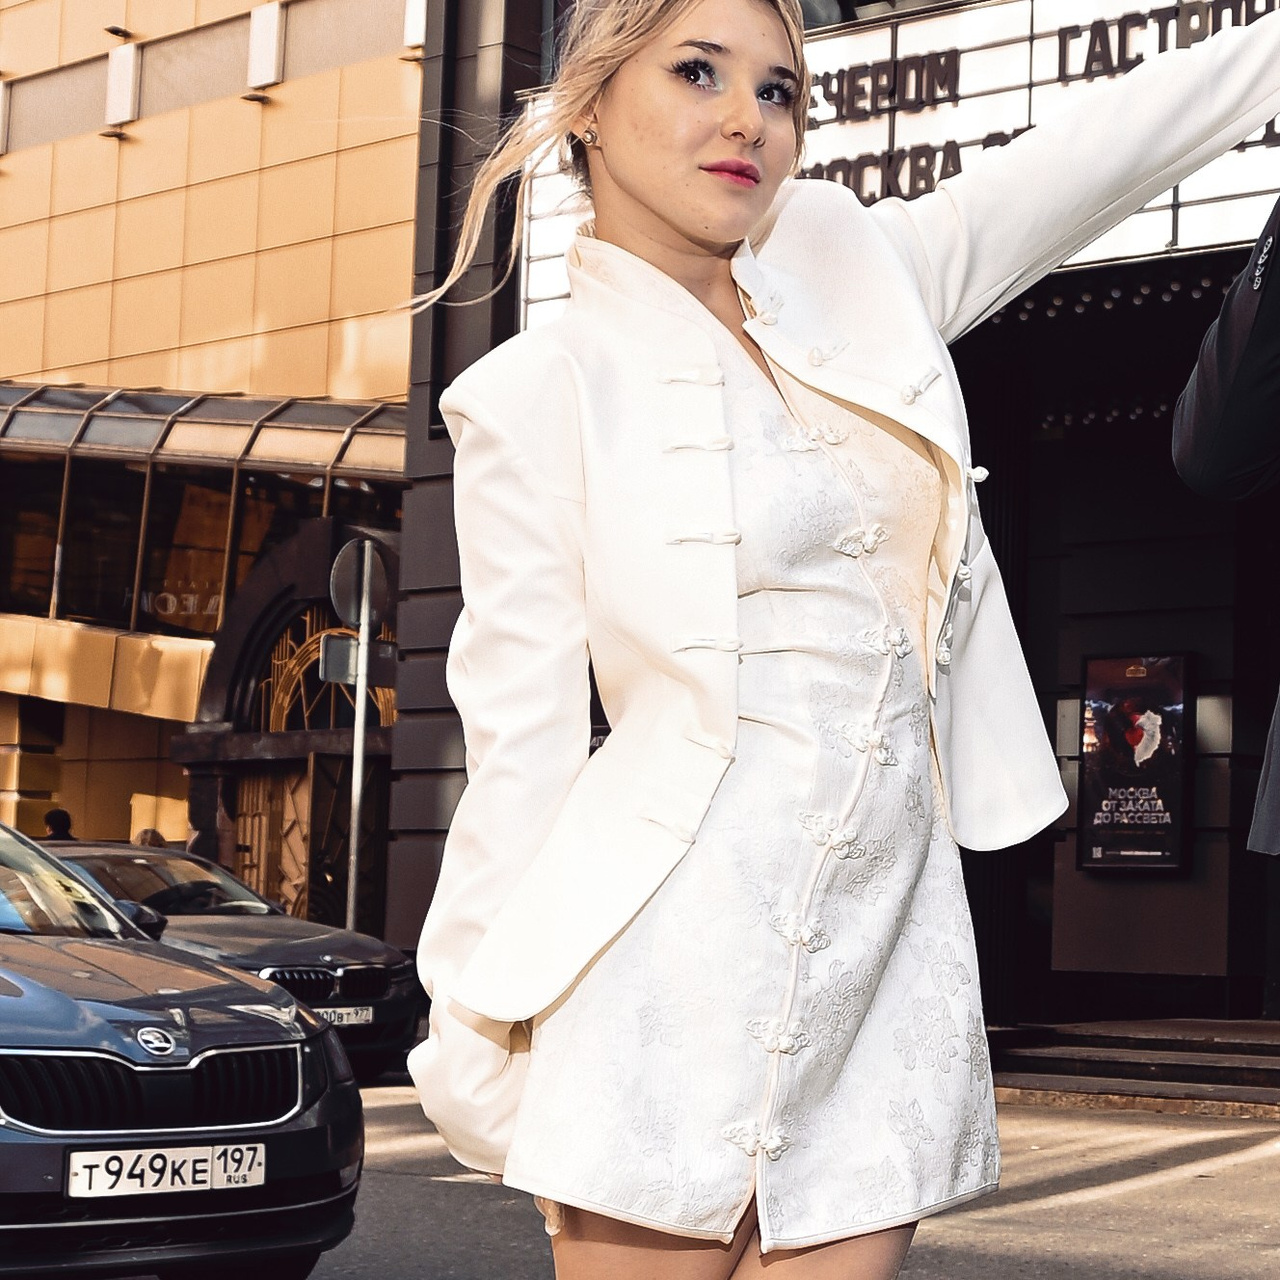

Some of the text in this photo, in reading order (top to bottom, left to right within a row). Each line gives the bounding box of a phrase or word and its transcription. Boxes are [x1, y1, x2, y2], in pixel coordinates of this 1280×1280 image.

[1108, 787, 1157, 799] МОСКВА
[1101, 799, 1164, 811] ОТ ЗАКАТА
[1093, 812, 1172, 825] ДО РАССВЕТА
[216, 1146, 258, 1173] 197
[226, 1174, 248, 1184] RUS
